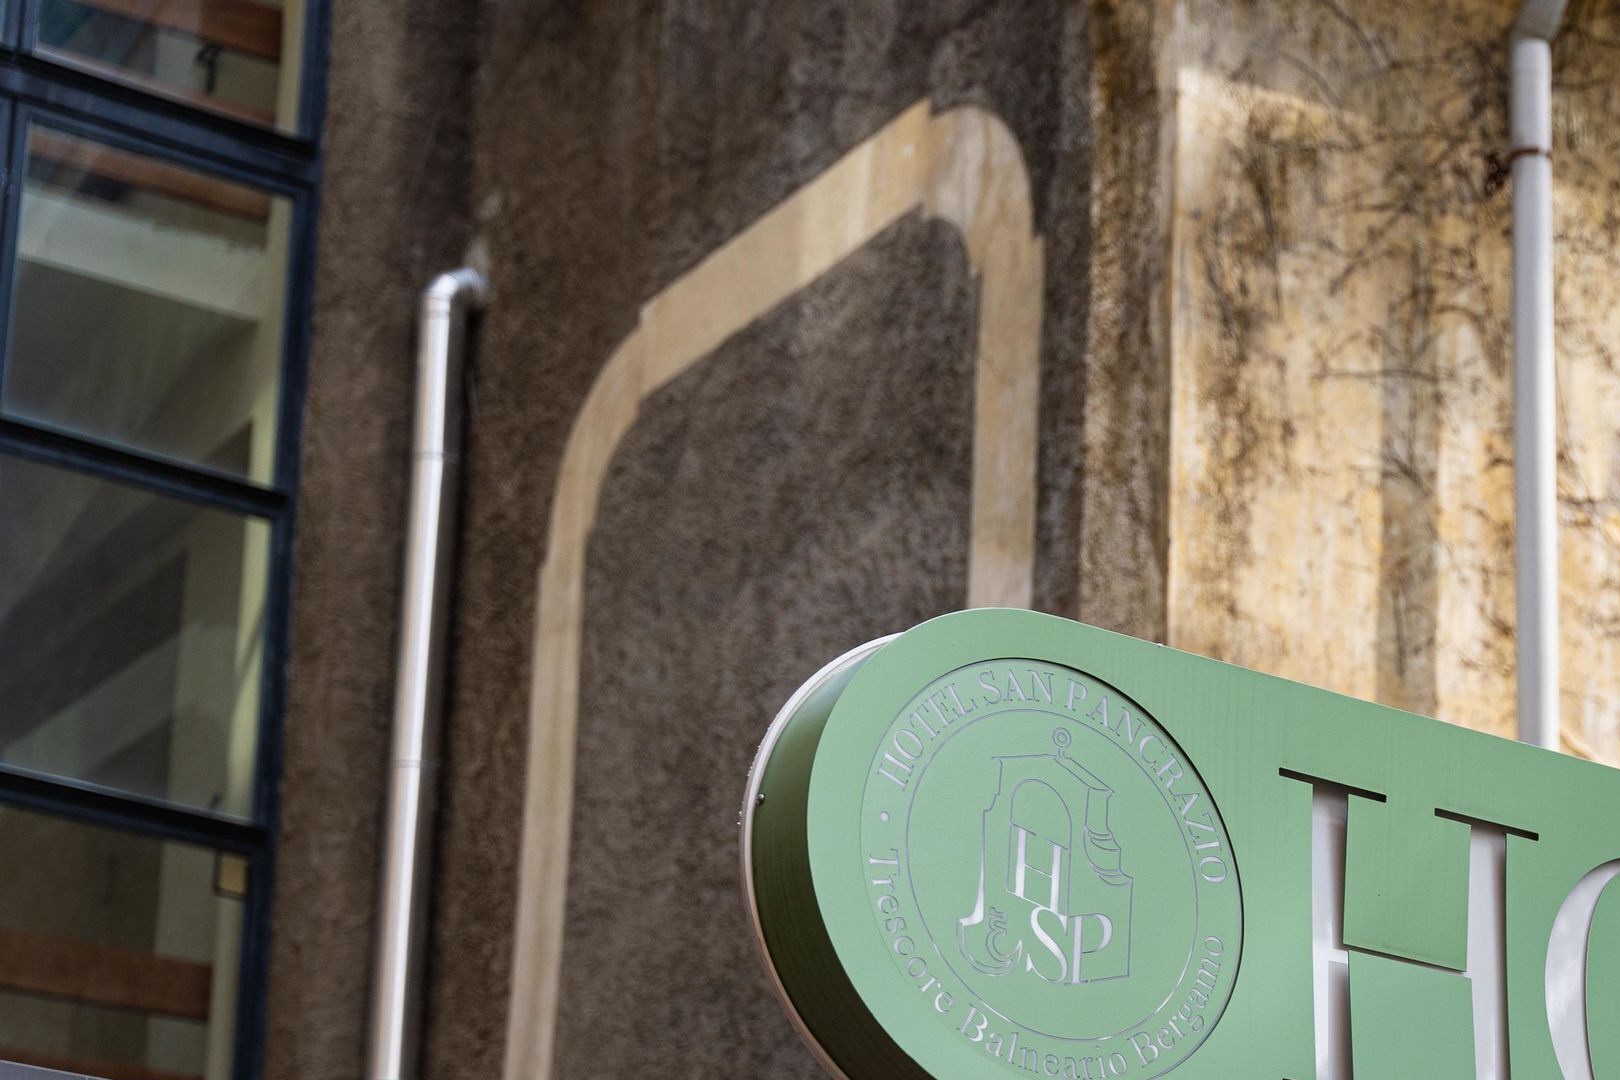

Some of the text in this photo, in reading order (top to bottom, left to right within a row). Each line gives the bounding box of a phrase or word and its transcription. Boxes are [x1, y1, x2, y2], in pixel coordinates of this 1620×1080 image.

[876, 668, 1228, 885] HOTEL SAN PANCRAZIO
[868, 846, 1226, 1080] Trescore Balneario Bergamo
